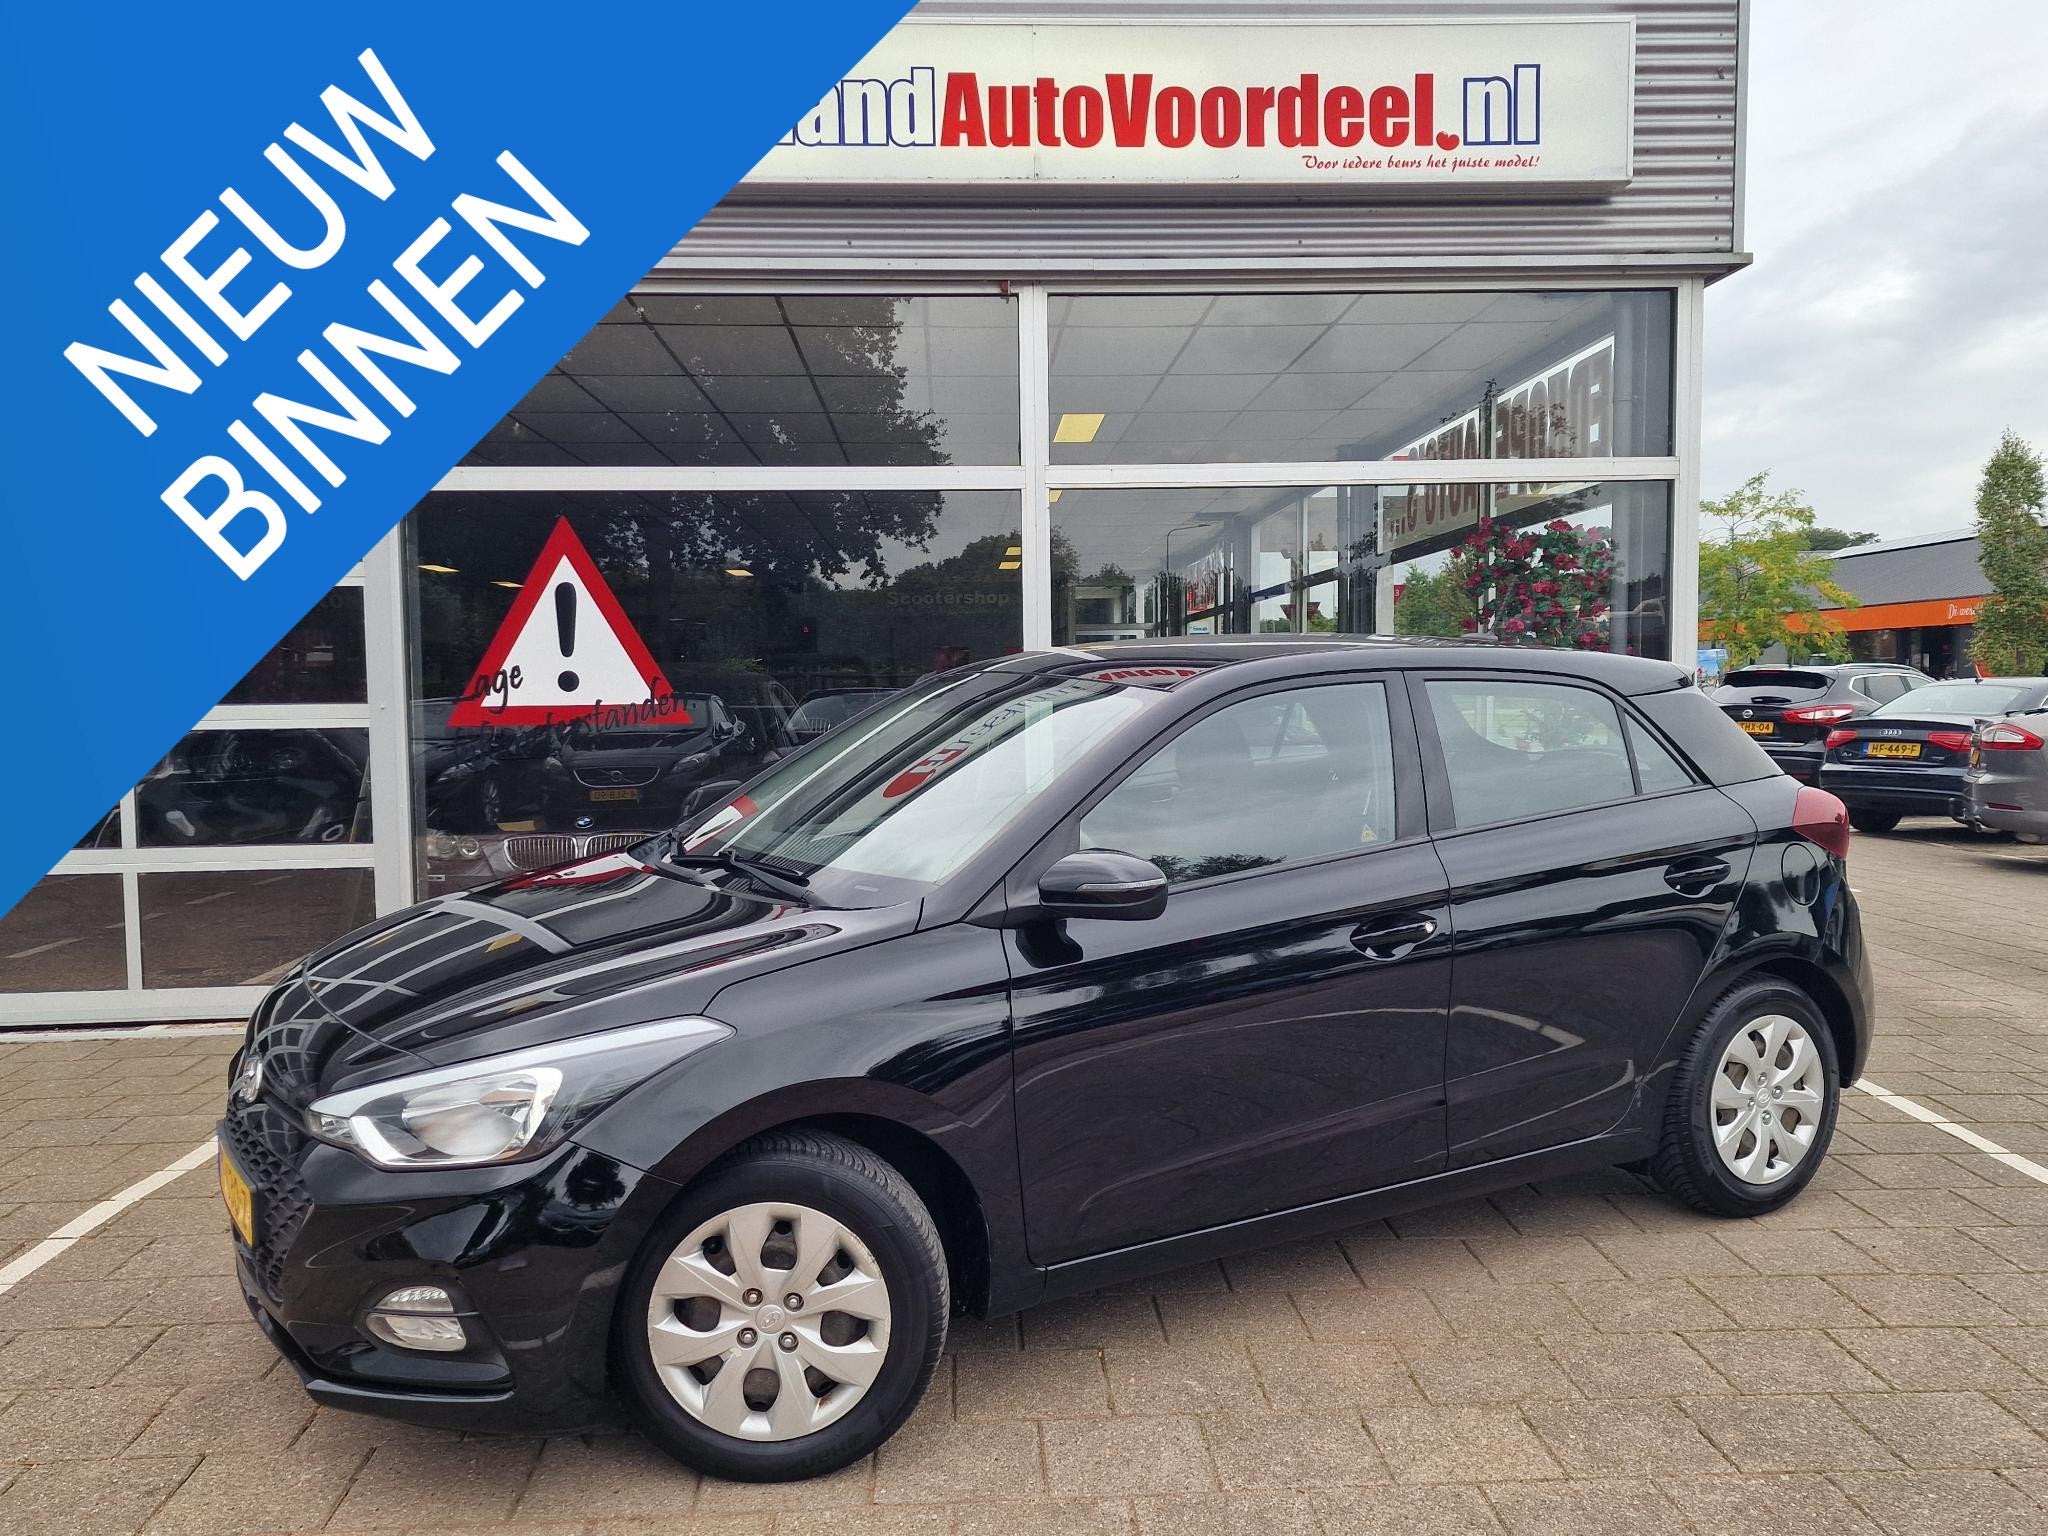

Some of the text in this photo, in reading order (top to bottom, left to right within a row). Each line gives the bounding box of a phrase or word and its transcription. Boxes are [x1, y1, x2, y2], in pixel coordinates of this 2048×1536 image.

[776, 63, 1541, 151] andAutoVoordeel.nl
[1301, 154, 1541, 173] Voor iedere beurs het juiste model!
[1871, 743, 1917, 754] HF-449-F
